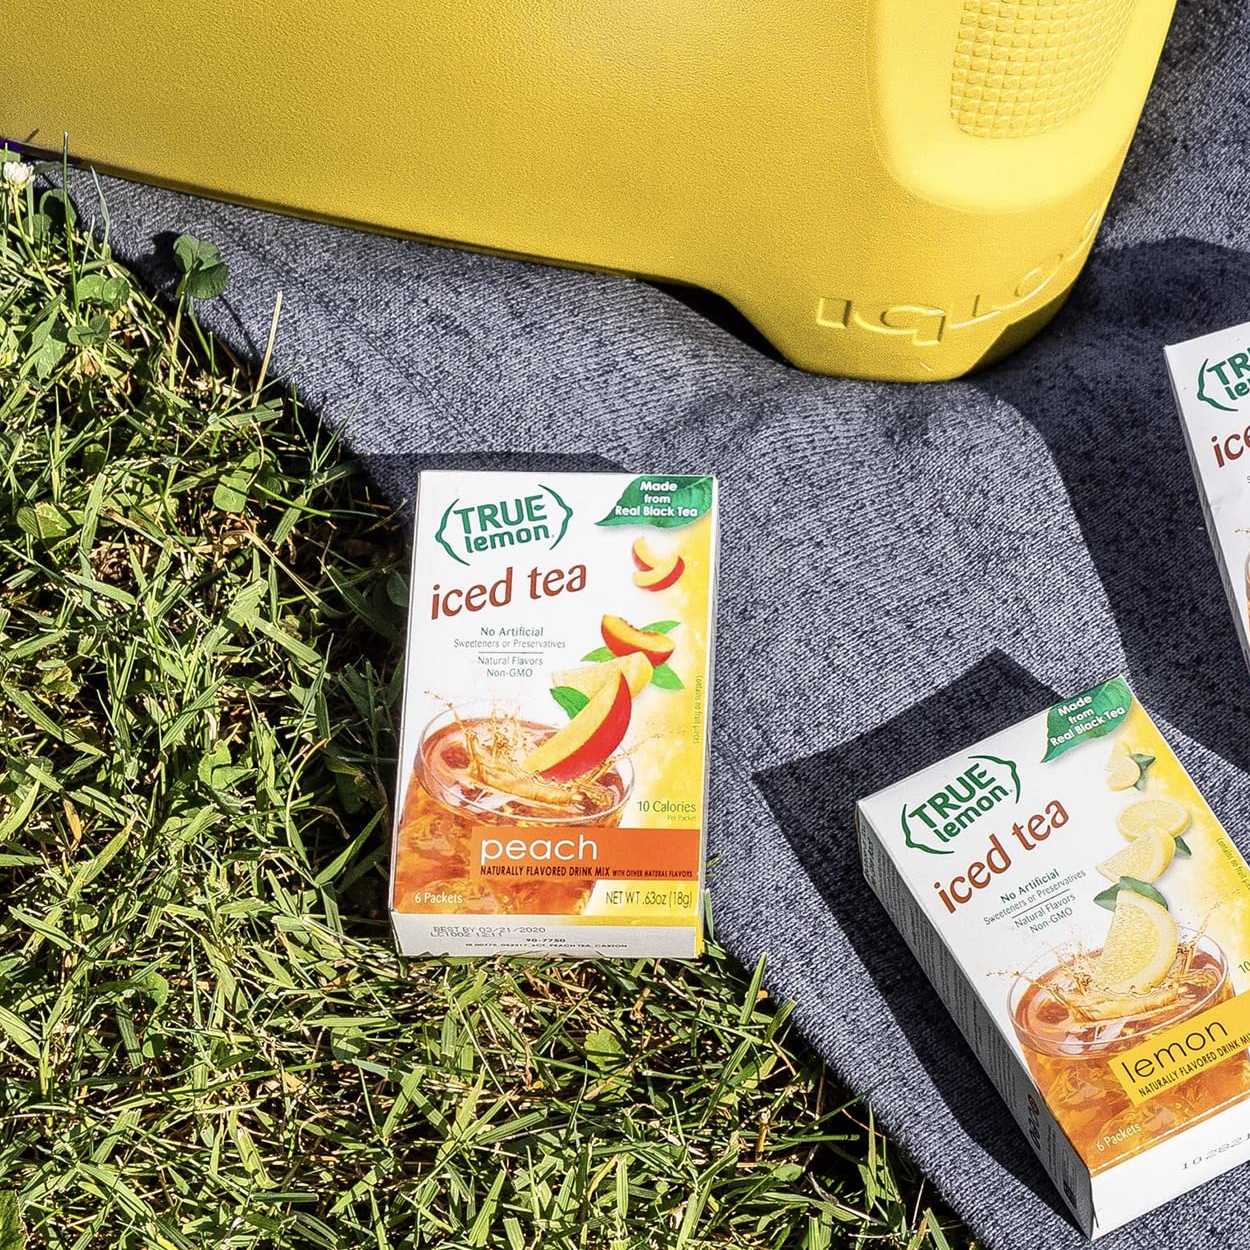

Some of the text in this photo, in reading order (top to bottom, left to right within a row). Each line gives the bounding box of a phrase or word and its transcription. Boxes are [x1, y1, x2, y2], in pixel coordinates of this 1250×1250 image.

[640, 481, 678, 491] Made
[644, 494, 671, 503] from
[453, 494, 547, 534] TRUE
[615, 506, 698, 517] Real Black Tea
[464, 525, 549, 553] lemon
[431, 564, 587, 620] iced tea
[454, 638, 566, 649] Sweeteners or Preservatives
[480, 626, 544, 637] No Artificial
[477, 656, 543, 665] Natural Flavors
[487, 668, 533, 678] Non-GMO
[1057, 694, 1093, 717] Made
[1069, 706, 1094, 724] from
[1049, 706, 1125, 747] Real Black Tea
[637, 800, 696, 813] 10 Calories
[908, 763, 996, 828] TRUE
[932, 785, 1009, 843] lemon
[480, 834, 598, 865] peach
[933, 833, 1012, 914] iced
[1012, 800, 1070, 851] tea
[480, 865, 524, 876] NATURALLY
[526, 866, 567, 877] FLAVORED
[569, 866, 592, 877] DRINK
[594, 867, 610, 877] MIX
[669, 870, 693, 878] FLAVORS
[414, 891, 463, 904] 6 Packets
[983, 869, 1086, 926] Sweeteners or Preservatives
[1000, 869, 1060, 903] No Artificial
[605, 891, 693, 909] NET WT .63oz (18g)
[1014, 893, 1076, 929] Natural Flavors
[1029, 907, 1074, 933] Non-GMO
[1121, 1020, 1229, 1083] lemon
[1138, 1070, 1179, 1098] NATURALLY
[1179, 1052, 1218, 1078] FLAVORED
[1216, 1039, 1240, 1059] DRINK
[1096, 1122, 1142, 1152] 6 Packets
